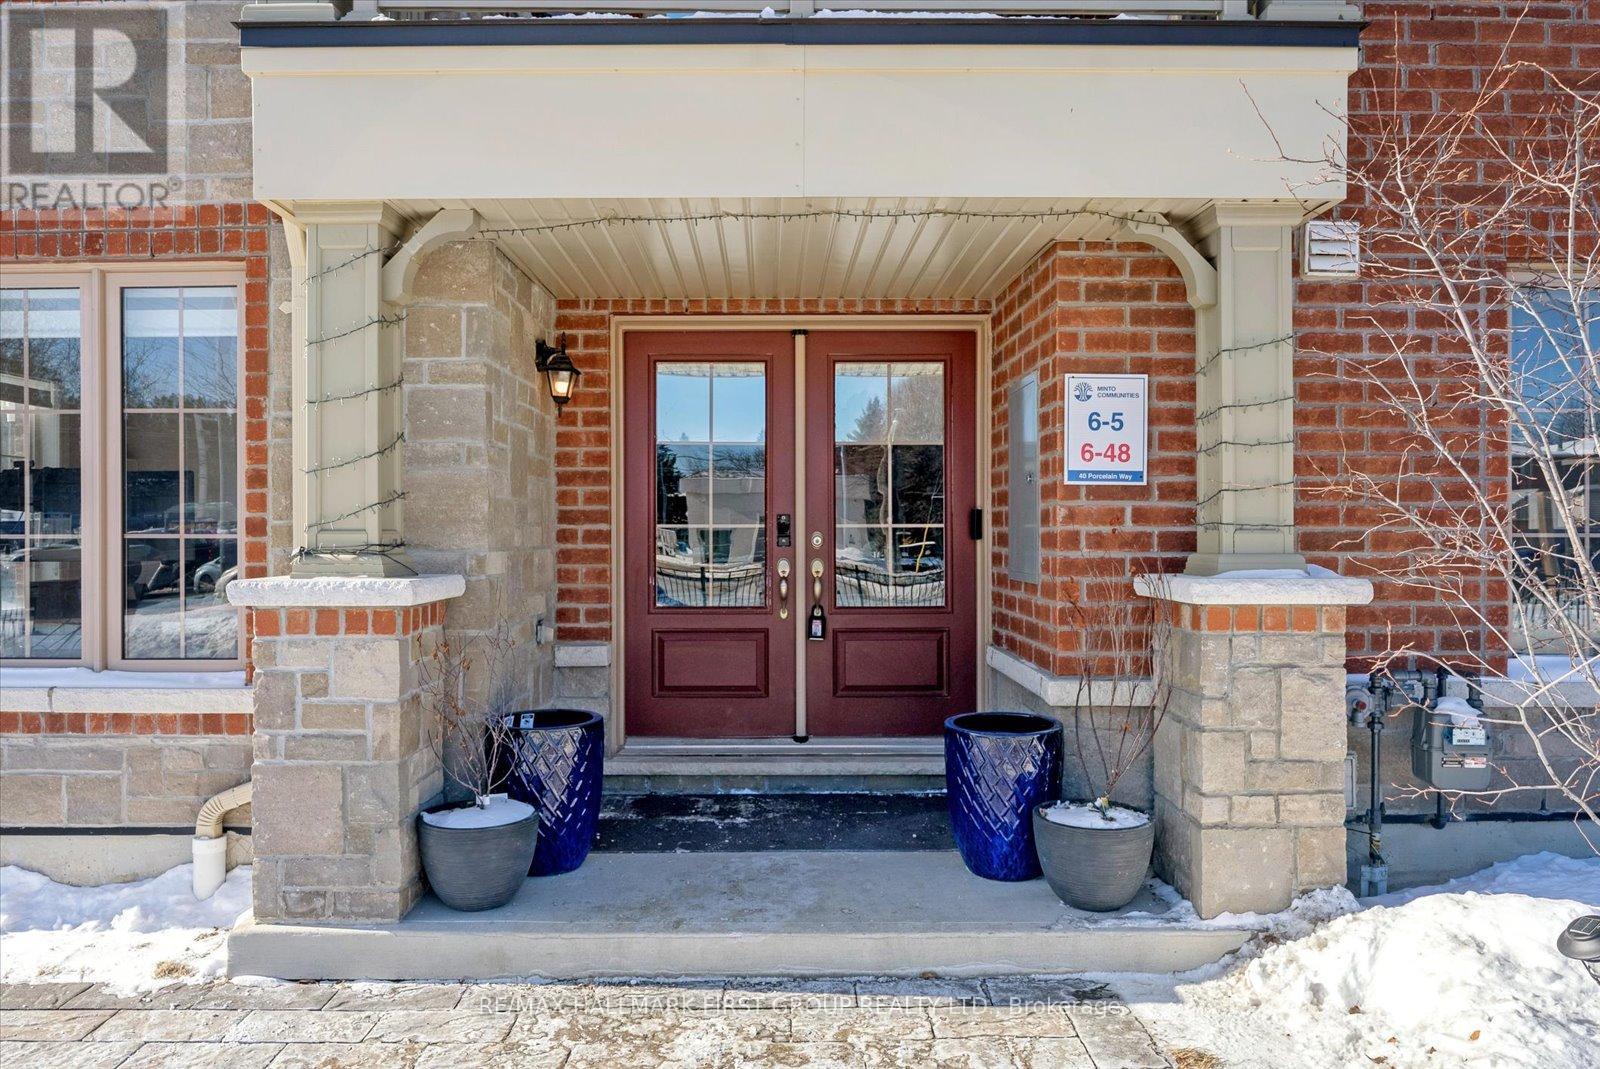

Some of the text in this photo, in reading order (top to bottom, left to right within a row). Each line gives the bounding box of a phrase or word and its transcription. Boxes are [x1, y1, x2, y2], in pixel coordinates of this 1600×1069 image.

[1088, 412, 1124, 431] 6-5
[1081, 443, 1131, 463] 6-48
[1119, 473, 1133, 481] Way
